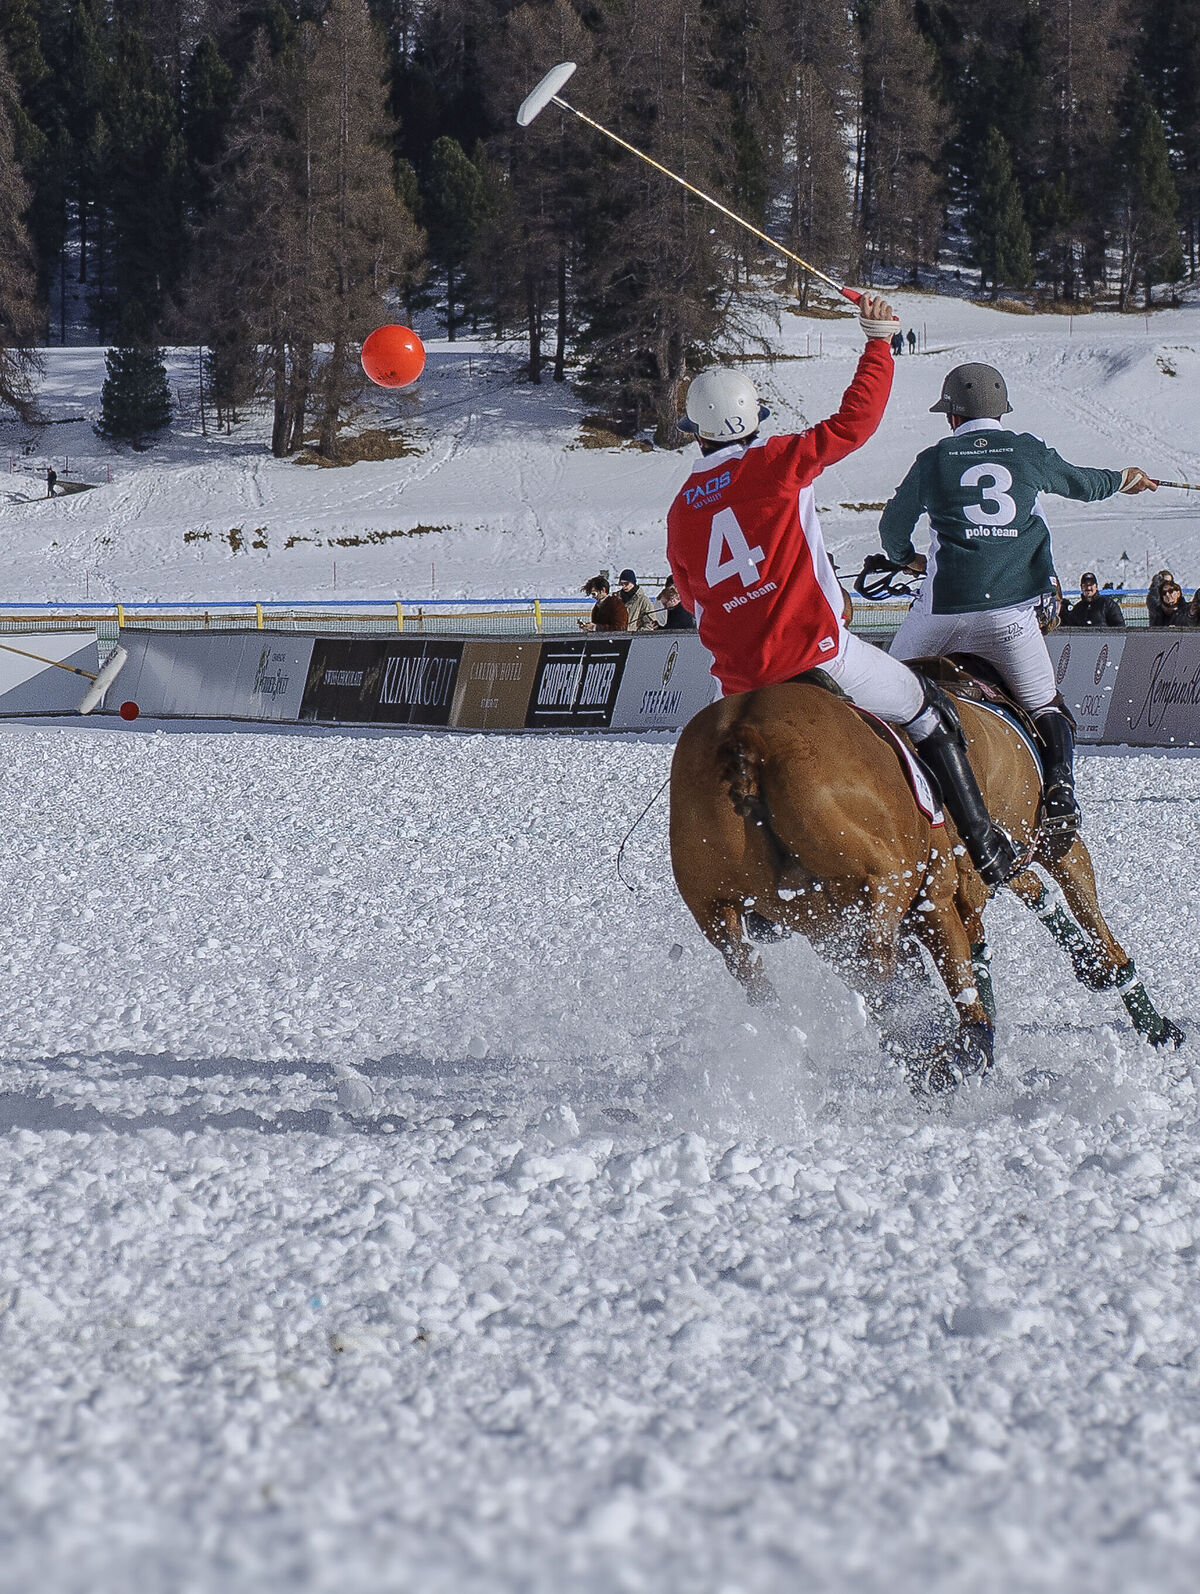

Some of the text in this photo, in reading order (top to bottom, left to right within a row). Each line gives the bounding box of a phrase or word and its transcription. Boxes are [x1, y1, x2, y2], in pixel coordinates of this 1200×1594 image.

[683, 471, 731, 505] TAOS
[960, 462, 1017, 526] 3
[705, 506, 766, 588] 4
[965, 525, 1019, 539] polo team
[722, 580, 778, 614] polo team
[379, 657, 458, 706] KLINIKGUT
[499, 662, 524, 681] HOTEL
[579, 663, 616, 705] BOXER
[640, 690, 683, 714] STEFFANI
